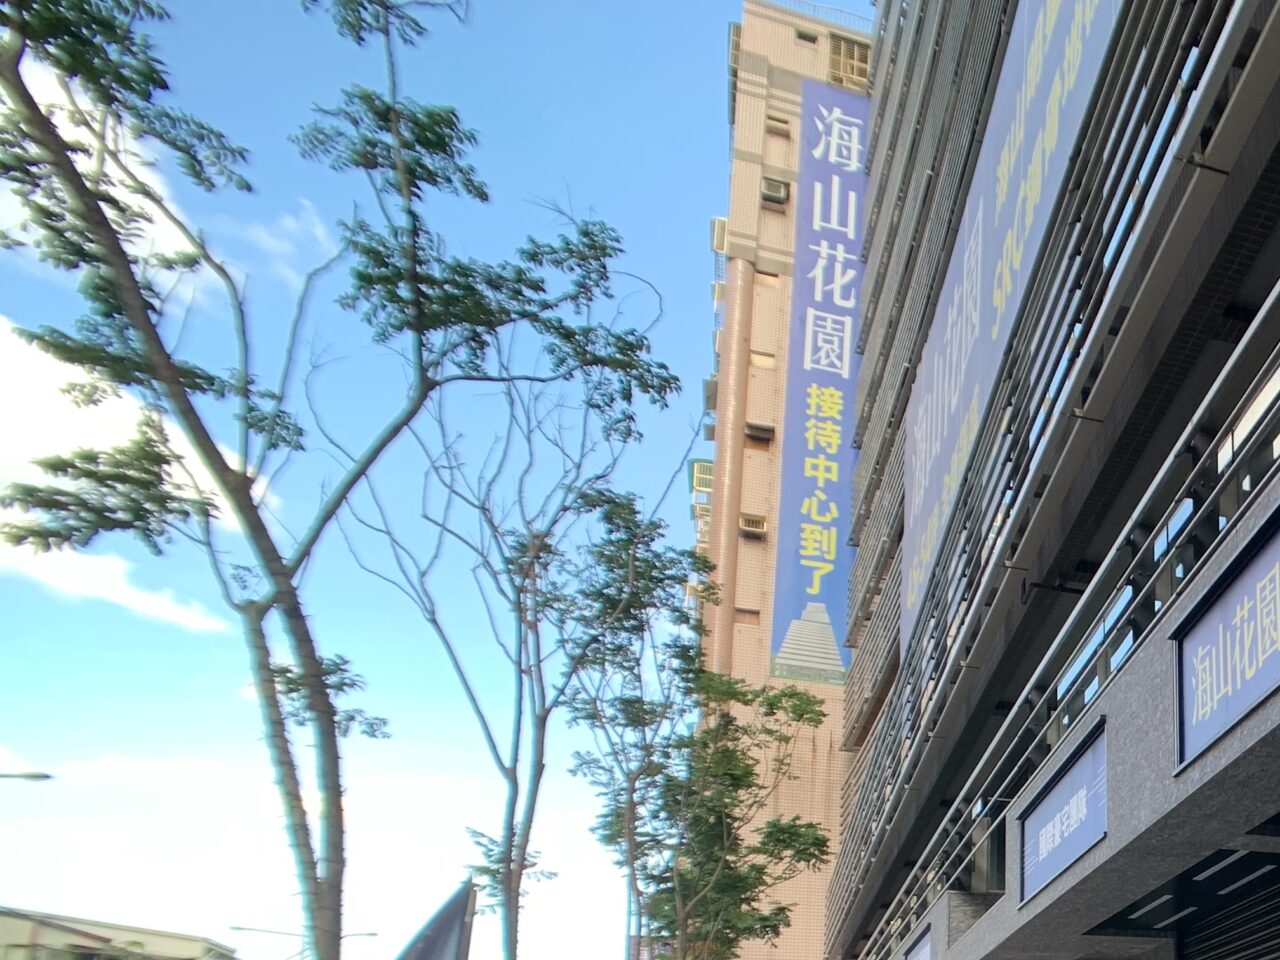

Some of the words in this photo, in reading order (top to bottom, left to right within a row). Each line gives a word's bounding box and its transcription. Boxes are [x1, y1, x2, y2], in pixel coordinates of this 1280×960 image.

[804, 103, 864, 379] 海山花園
[799, 383, 843, 595] 接待中心到了
